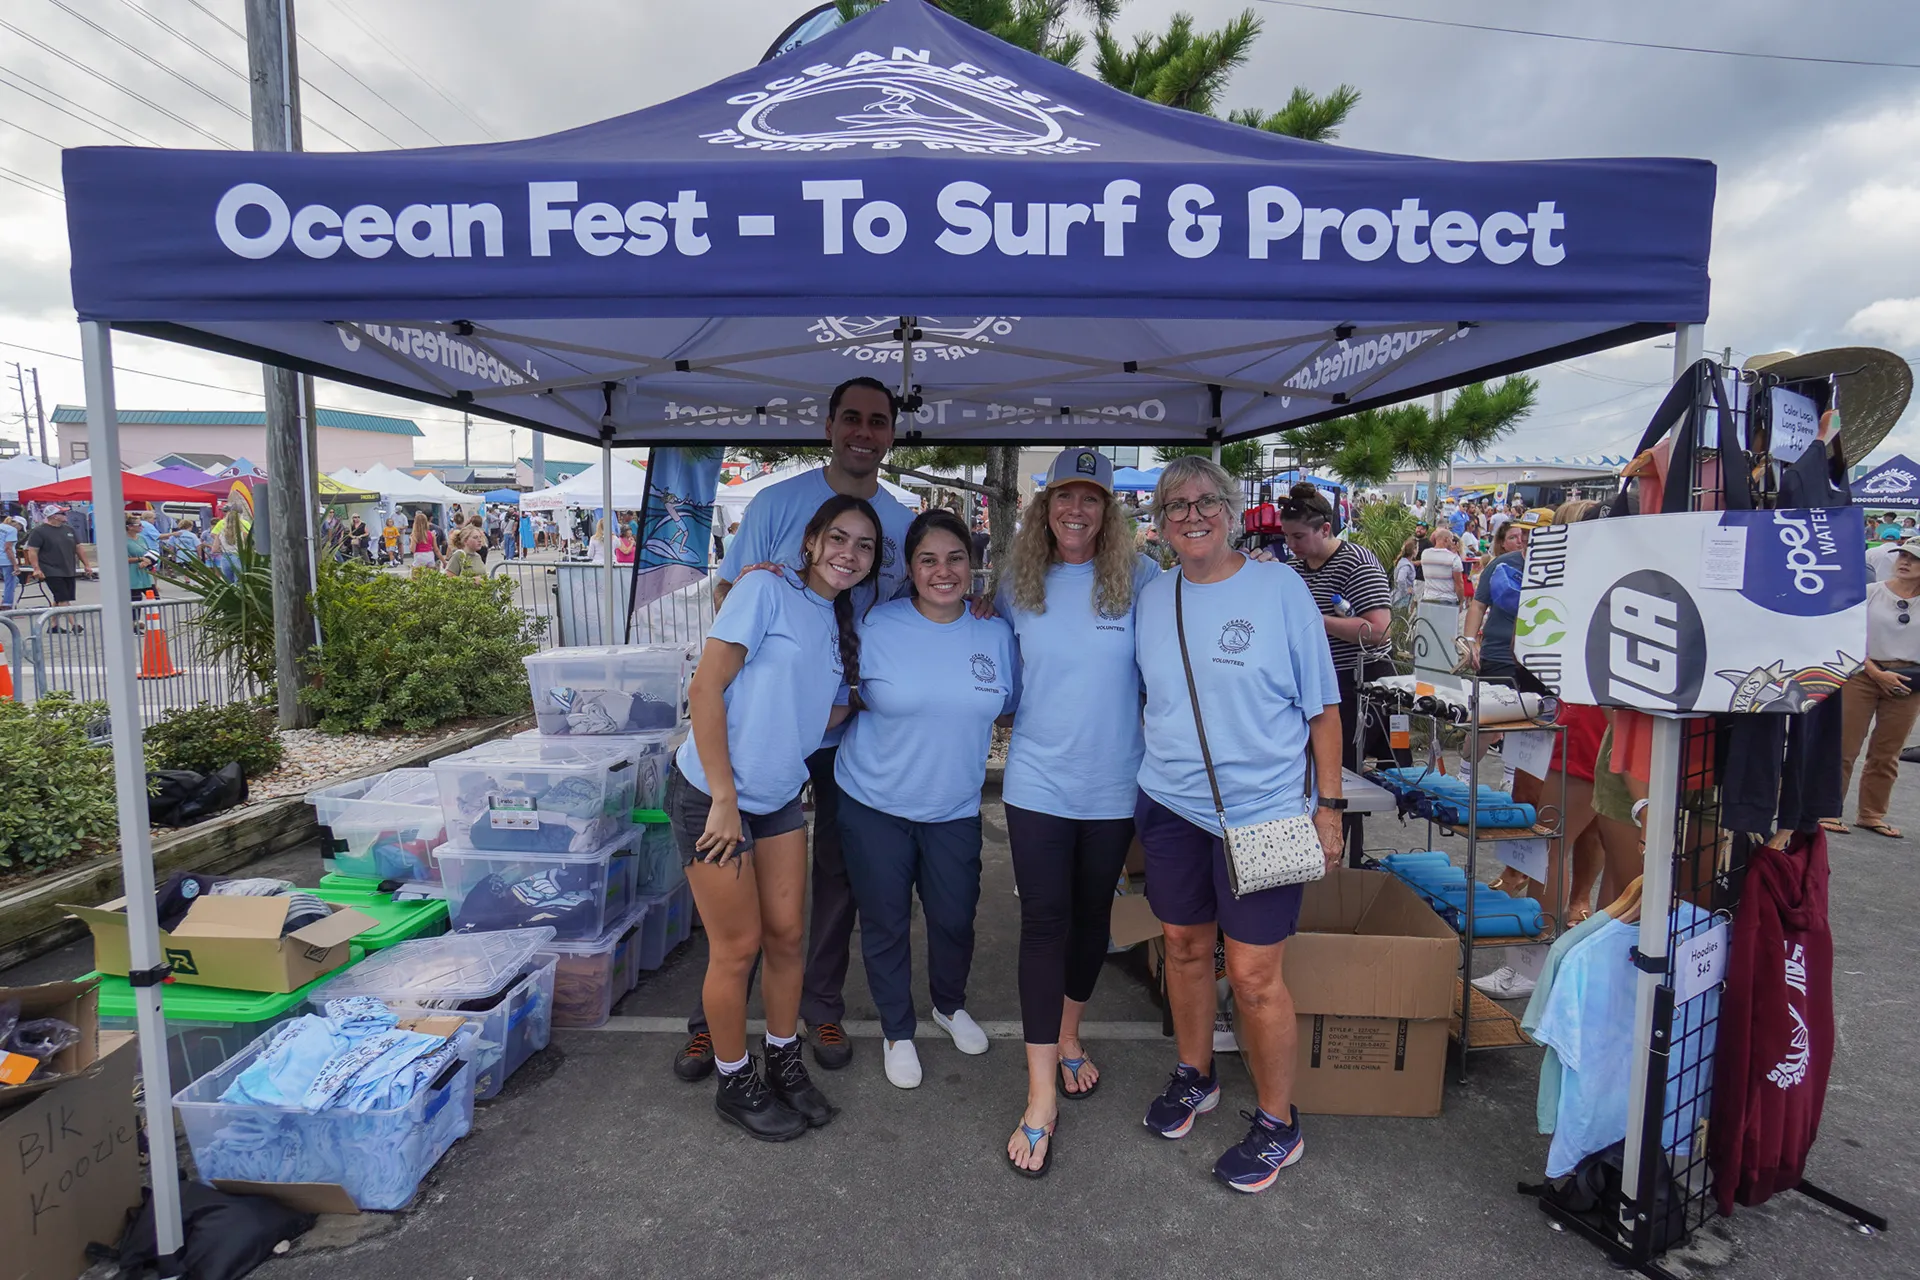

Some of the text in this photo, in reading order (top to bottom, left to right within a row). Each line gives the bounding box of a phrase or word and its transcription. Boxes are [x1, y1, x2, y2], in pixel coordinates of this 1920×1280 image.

[727, 46, 1085, 116] OCEAN FEST
[698, 128, 745, 144] TO
[733, 141, 857, 151] SURF
[922, 137, 1101, 155] PROTECT
[215, 179, 1566, 266] Ocean Fest - To Surf & Protect
[1782, 419, 1815, 436] Long Sleeve
[1608, 585, 1678, 710] IGA
[1212, 657, 1245, 667] VOLUNTEER
[1690, 940, 1719, 962] Hoodies
[1696, 960, 1711, 979] $45
